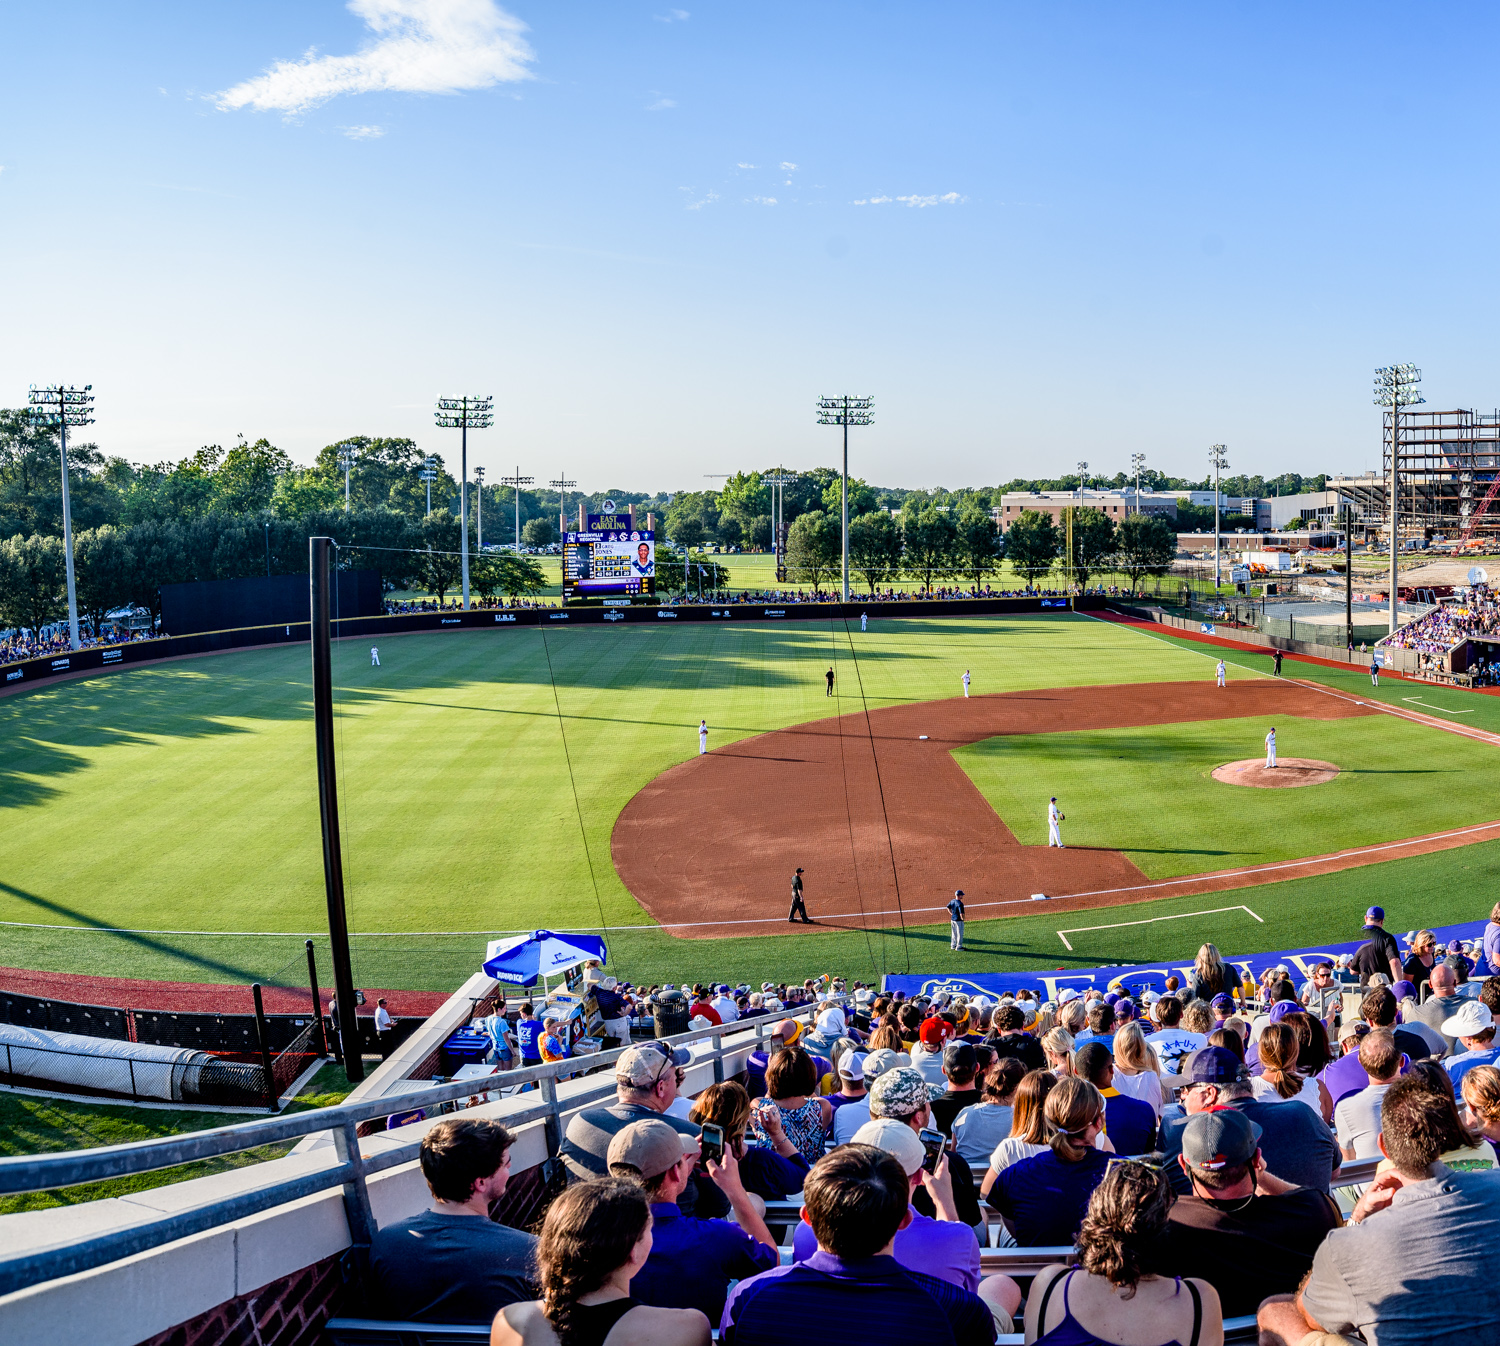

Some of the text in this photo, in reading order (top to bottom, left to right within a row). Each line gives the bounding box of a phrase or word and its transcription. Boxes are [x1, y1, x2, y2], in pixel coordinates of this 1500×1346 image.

[600, 515, 618, 523] EAST
[591, 521, 627, 530] CAROLINA
[932, 985, 963, 993] ECU
